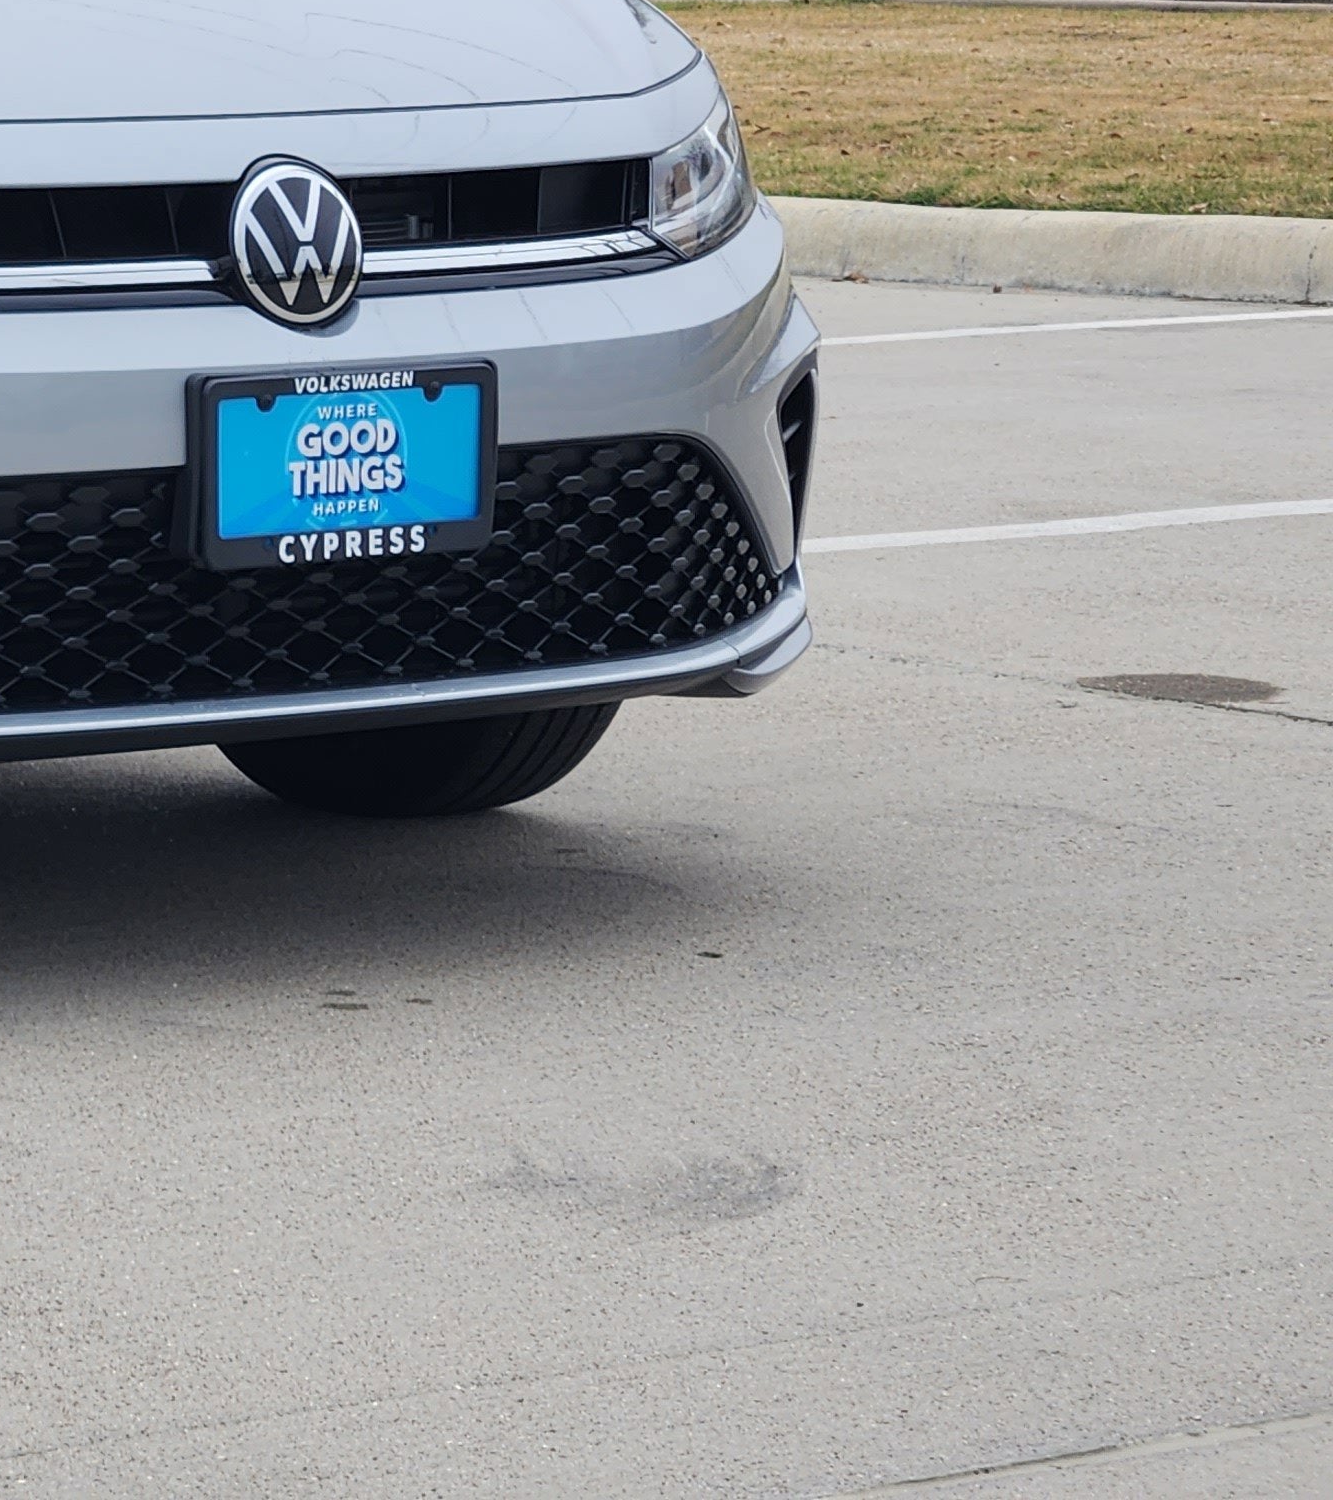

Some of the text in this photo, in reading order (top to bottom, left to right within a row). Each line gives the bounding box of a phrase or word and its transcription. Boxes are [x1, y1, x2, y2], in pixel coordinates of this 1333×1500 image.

[294, 371, 415, 394] VOLKSWAGEN
[317, 403, 377, 420] WHERE
[297, 419, 396, 457] GOOD
[288, 454, 403, 496] THINGS
[312, 499, 380, 516] HAPPEN
[278, 525, 426, 564] CYPRESS
